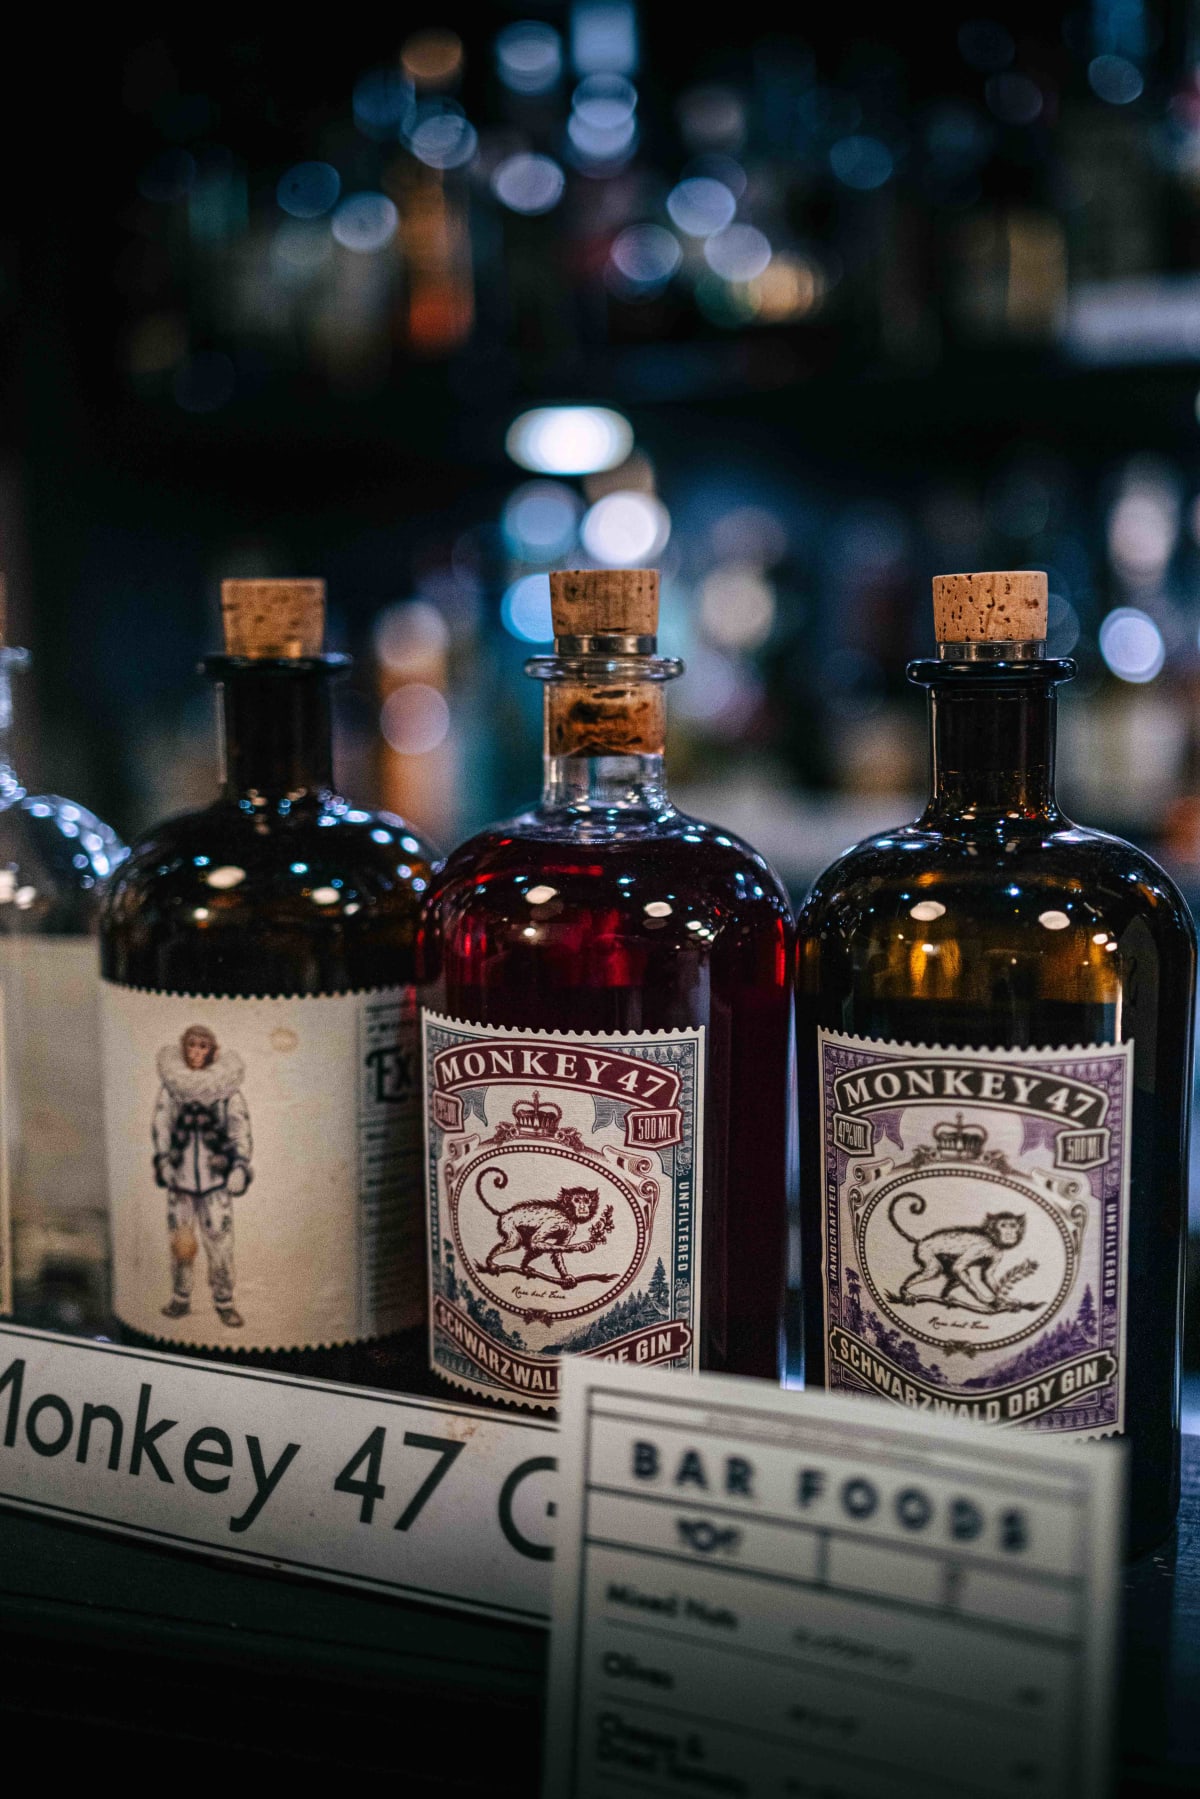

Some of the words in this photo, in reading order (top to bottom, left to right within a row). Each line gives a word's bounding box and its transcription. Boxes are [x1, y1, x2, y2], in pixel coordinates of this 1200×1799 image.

[440, 1050, 612, 1085] MONKEY
[617, 1069, 667, 1098] 47
[843, 1069, 1041, 1107] MONKEY
[1045, 1087, 1097, 1118] 47
[638, 1117, 656, 1140] 500
[658, 1116, 672, 1139] ML
[678, 1182, 690, 1271] UNFILTERED
[828, 1185, 838, 1281] HANDCRAFTED
[1105, 1204, 1117, 1297] UNFILTERED
[440, 1304, 561, 1392] SCHWARZWAL
[636, 1331, 672, 1362] GIN
[840, 1337, 1001, 1423] SCHWARZWALD
[1008, 1378, 1056, 1418] DRY
[1061, 1360, 1098, 1394] GIN
[333, 1426, 467, 1531] 47
[632, 1440, 757, 1499] BAR
[796, 1468, 1030, 1553] FOODS
